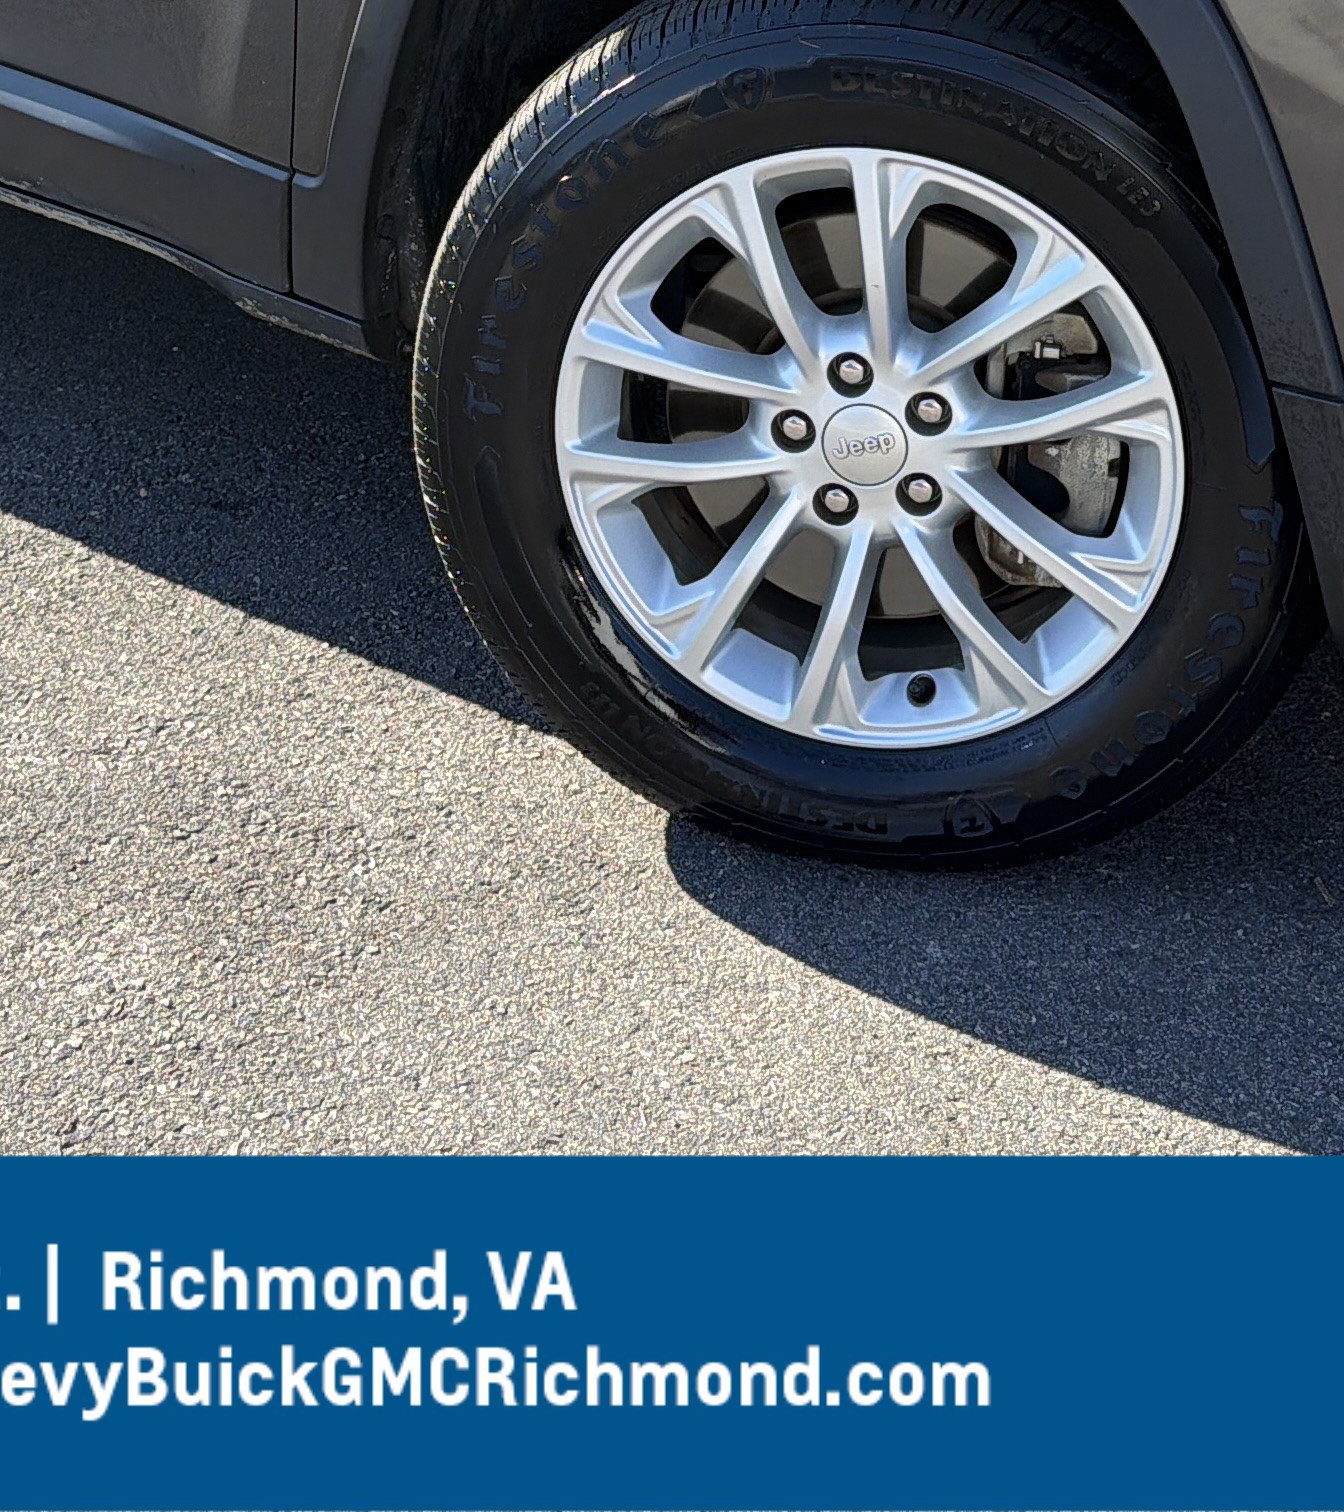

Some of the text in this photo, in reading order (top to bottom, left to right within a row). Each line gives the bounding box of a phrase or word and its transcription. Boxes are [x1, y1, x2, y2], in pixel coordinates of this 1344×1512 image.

[462, 110, 660, 424] Firestone
[832, 432, 896, 460] Jeep
[1049, 500, 1284, 800] Firestone
